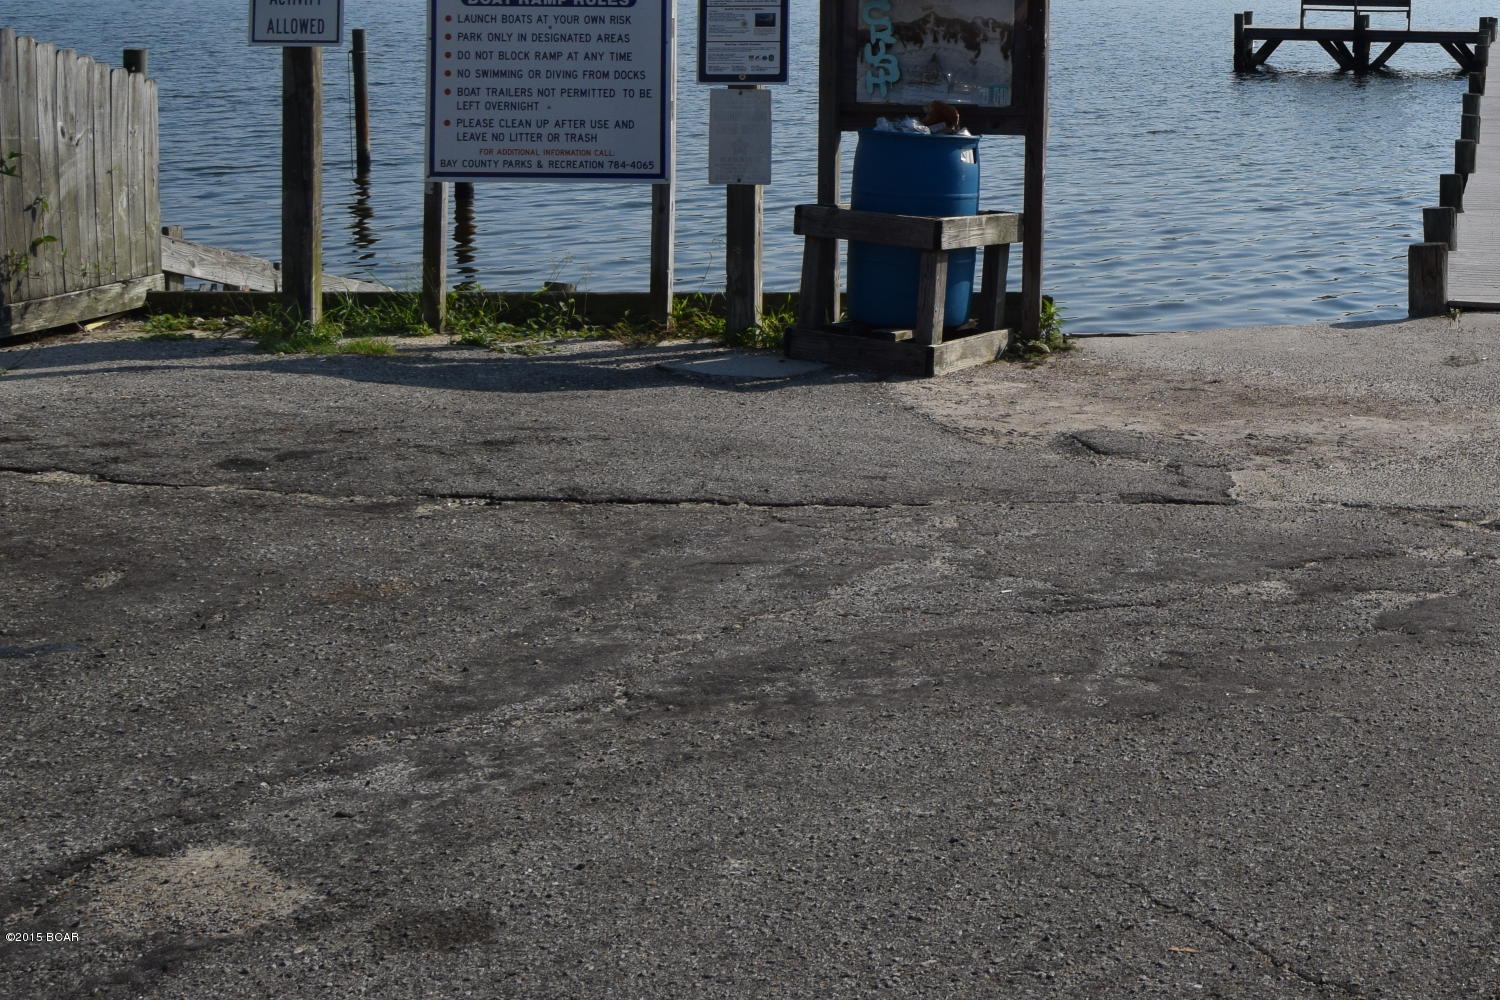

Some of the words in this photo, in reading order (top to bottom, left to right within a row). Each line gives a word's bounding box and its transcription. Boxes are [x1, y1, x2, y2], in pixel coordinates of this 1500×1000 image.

[457, 14, 497, 24] LAUNCH
[501, 14, 533, 25] BOATS
[536, 14, 548, 25] AT
[553, 15, 581, 25] YOUR
[584, 15, 606, 25] OWN
[609, 15, 631, 25] RISK
[266, 18, 325, 34] ALLOWED
[457, 33, 483, 42] PARK
[487, 33, 513, 42] ONLY
[517, 33, 527, 42] IN
[531, 33, 592, 43] DESIGNATED
[596, 33, 630, 43] AREAS
[457, 51, 470, 60] DO
[475, 51, 494, 60] NOT
[498, 51, 530, 61] BLOCK
[534, 51, 563, 61] RAMP
[566, 51, 578, 61] AT
[583, 52, 605, 61] ANY
[610, 52, 633, 62] TIME
[457, 69, 470, 78] NO
[475, 69, 523, 79] SWIMMING
[528, 70, 542, 79] OR
[545, 70, 578, 80] DIVING
[582, 70, 610, 80] FROM
[614, 70, 646, 80] DOCKS
[457, 87, 481, 97] BOAT
[486, 88, 533, 97] TRAILERS
[537, 88, 556, 98] NOT
[560, 88, 616, 98] PERMITTED
[622, 89, 635, 98] TO
[639, 89, 652, 99] BE
[456, 101, 480, 110] LEFT
[484, 101, 539, 111] OVERNIGHT
[456, 119, 494, 129] PLEASE
[499, 119, 531, 129] CLEAN
[536, 119, 549, 129] UP
[554, 119, 586, 129] AFTER
[590, 120, 609, 129] USE
[614, 120, 635, 130] AND
[456, 133, 488, 142] LEAVE
[491, 133, 505, 142] NO
[509, 133, 543, 143] LITTER
[547, 133, 560, 143] OR
[565, 133, 598, 143] TRASH
[479, 148, 494, 156] FOR
[543, 149, 592, 157] INFORMATION
[439, 159, 457, 168] BAY
[462, 159, 498, 169] COUNTY
[502, 159, 532, 169] PARKS
[536, 160, 543, 169] &
[548, 160, 604, 169] RECREATION
[608, 161, 655, 170] 784-4065
